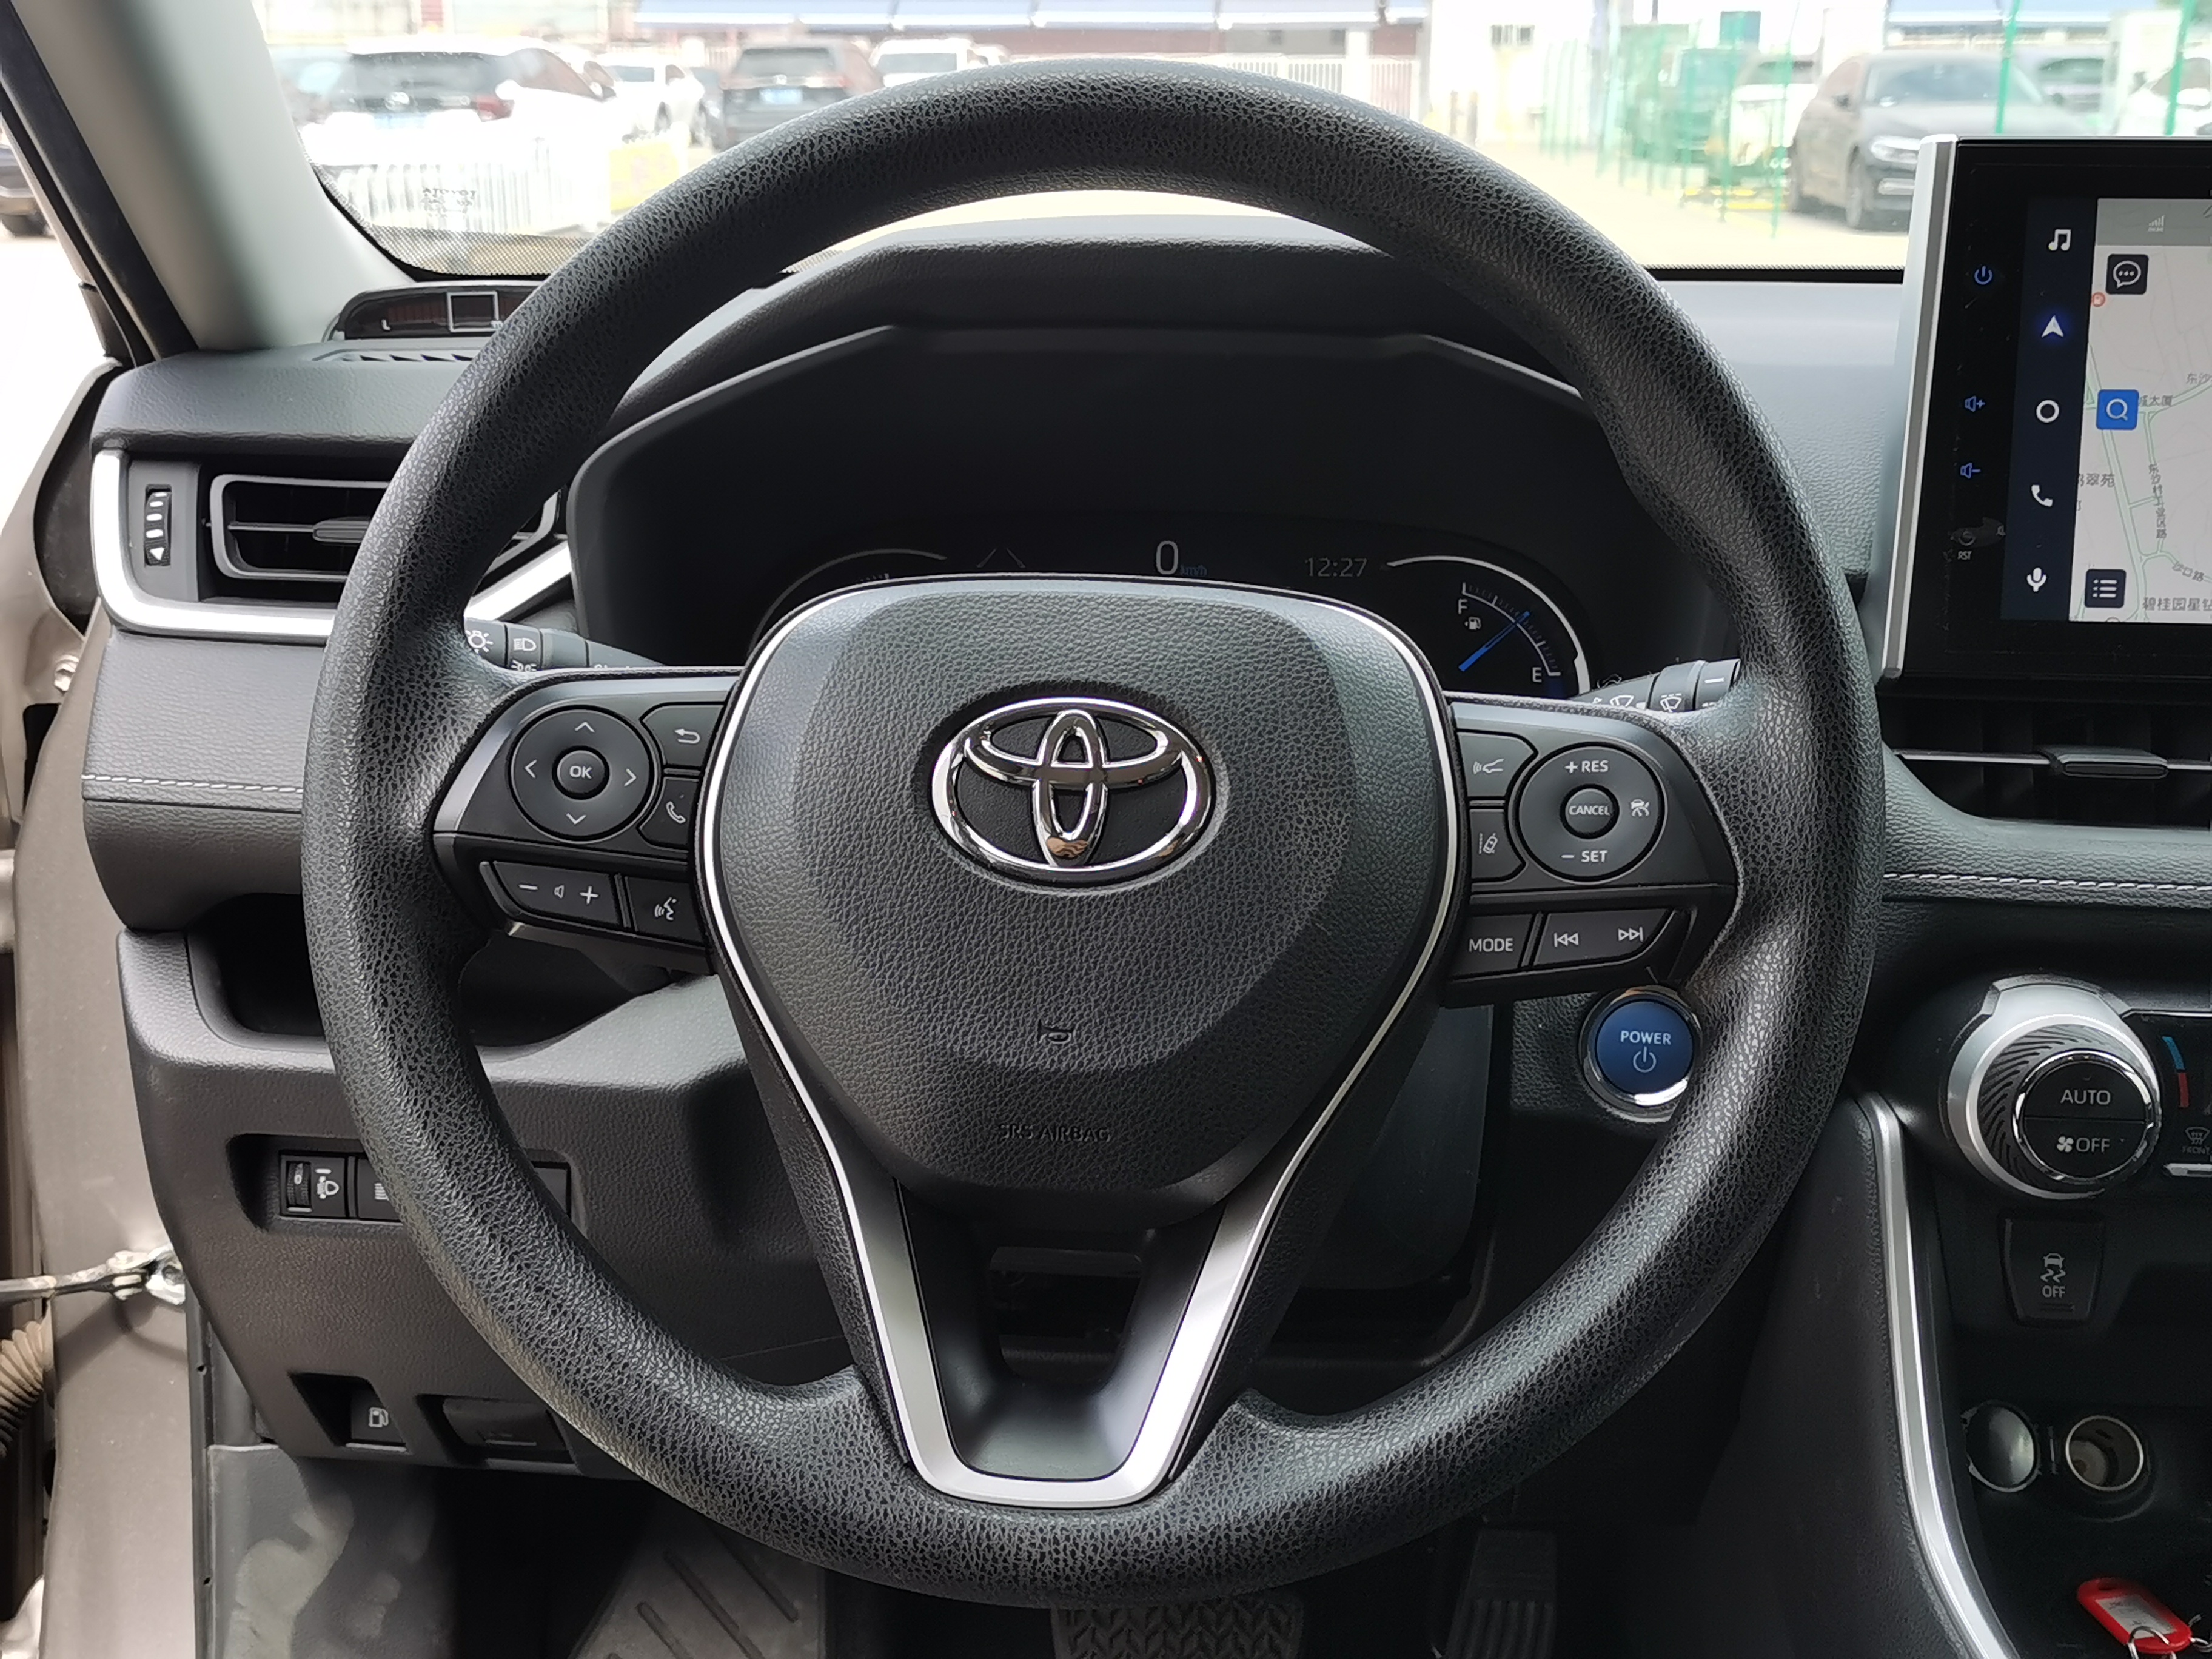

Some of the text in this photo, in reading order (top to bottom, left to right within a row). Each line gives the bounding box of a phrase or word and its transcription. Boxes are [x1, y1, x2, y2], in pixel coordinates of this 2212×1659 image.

[1156, 541, 1179, 575] 0
[1305, 557, 1367, 577] 12:27
[1458, 598, 1468, 614] F
[1532, 666, 1542, 683] E
[569, 765, 592, 779] OK
[1569, 805, 1611, 817] CANCEL
[1469, 937, 1514, 952] MODE
[1620, 1030, 1672, 1045] POWER
[2060, 1089, 2111, 1105] AUTO
[1039, 1125, 1111, 1142] AIRBAG
[2076, 1138, 2110, 1153] OFF
[2042, 1285, 2066, 1298] OFF
